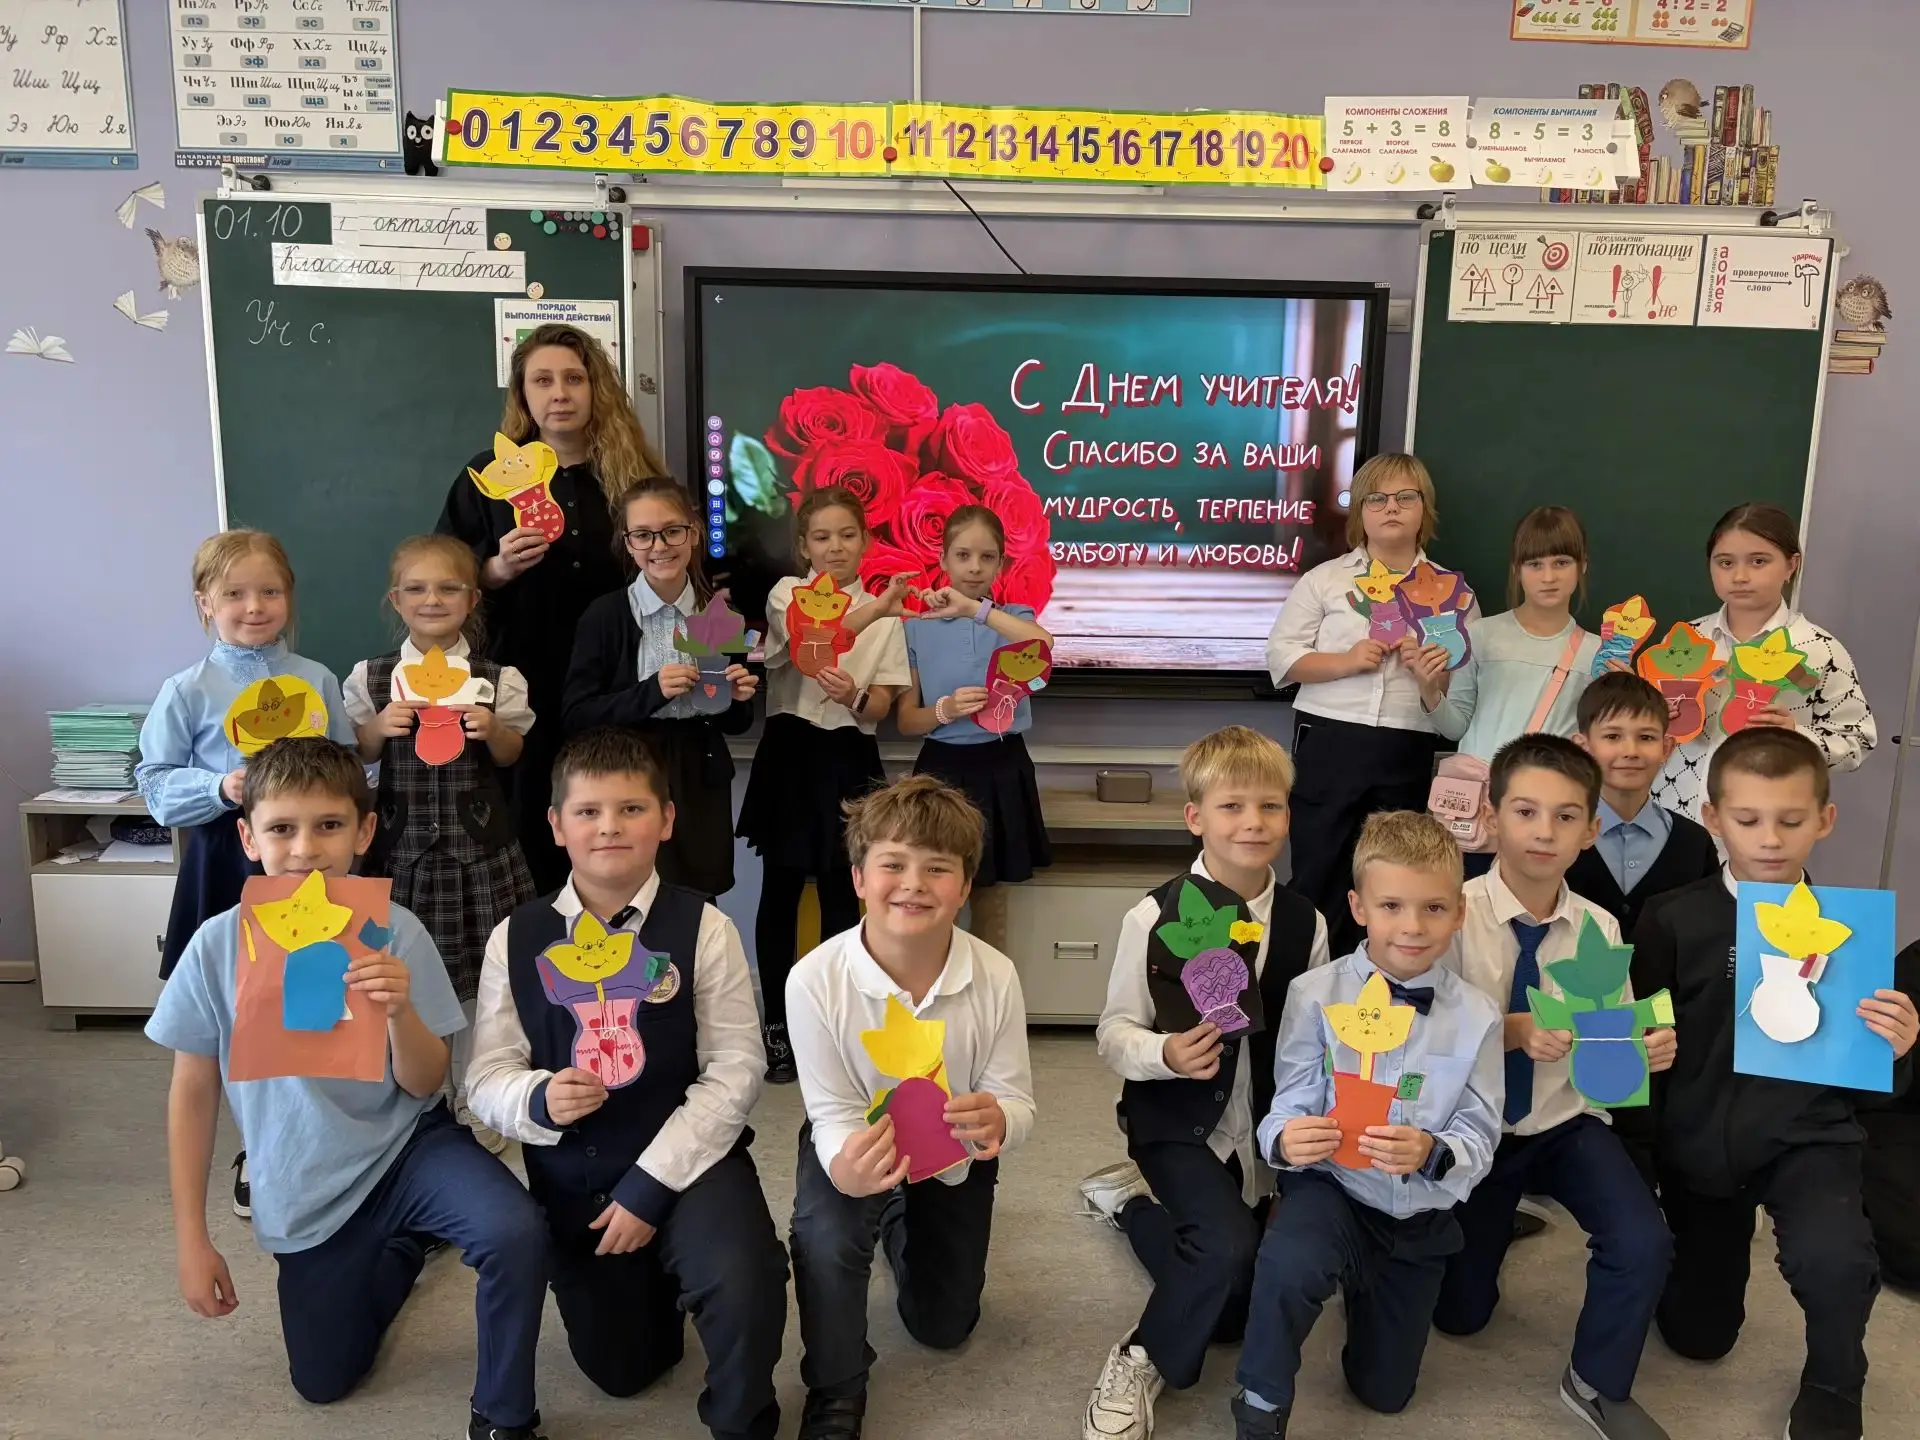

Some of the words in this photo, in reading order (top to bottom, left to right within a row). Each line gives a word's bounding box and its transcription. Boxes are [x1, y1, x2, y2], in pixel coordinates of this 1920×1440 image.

[1345, 107, 1400, 116] КОМПОНЕНТЫ
[1402, 107, 1448, 116] СЛОЖЕНИЯ
[1493, 107, 1549, 115] КОМПОНЕНТЫ
[1550, 108, 1598, 116] ВЫЧИТАНИЯ
[462, 108, 489, 149] 0
[501, 108, 522, 151] 1
[532, 109, 563, 152] 2
[570, 113, 599, 155] 3
[606, 113, 636, 156] 4
[643, 111, 671, 155] 5
[679, 115, 708, 157] 6
[716, 118, 745, 159] 7
[753, 118, 779, 160] 8
[789, 118, 816, 159] 9
[827, 119, 875, 160] 10
[1343, 120, 1354, 137] 5
[1367, 122, 1378, 134] +
[1390, 120, 1402, 137] 3
[1414, 124, 1426, 133] =
[1438, 120, 1450, 137] 8
[1489, 121, 1501, 139] 8
[1533, 122, 1546, 140] 5
[1557, 127, 1569, 137] =
[1581, 123, 1593, 141] 3
[904, 118, 932, 157] 11
[942, 119, 976, 159] 12
[984, 123, 1018, 161] 13
[1024, 124, 1059, 163] 14
[1066, 125, 1100, 164] 15
[1107, 128, 1141, 166] 16
[1149, 129, 1182, 167] 17
[1190, 129, 1224, 167] 18
[1231, 130, 1265, 167] 19
[1271, 131, 1309, 169] 20
[373, 207, 479, 246] октября
[1489, 241, 1527, 257] цели
[1587, 242, 1608, 256] по
[1608, 243, 1694, 260] интонации
[280, 244, 395, 276] Классная
[416, 251, 514, 287] работа
[1792, 253, 1823, 263] ударный
[1732, 268, 1789, 279] проверочное
[1746, 284, 1771, 292] слово
[536, 303, 577, 312] ПОРЯДОК
[505, 312, 564, 321] ВЫПОЛНЕНИЯ
[566, 313, 612, 322] ДЕЙСТВИЙ
[1010, 359, 1042, 411] С
[1726, 946, 1736, 979] KIPSTA
